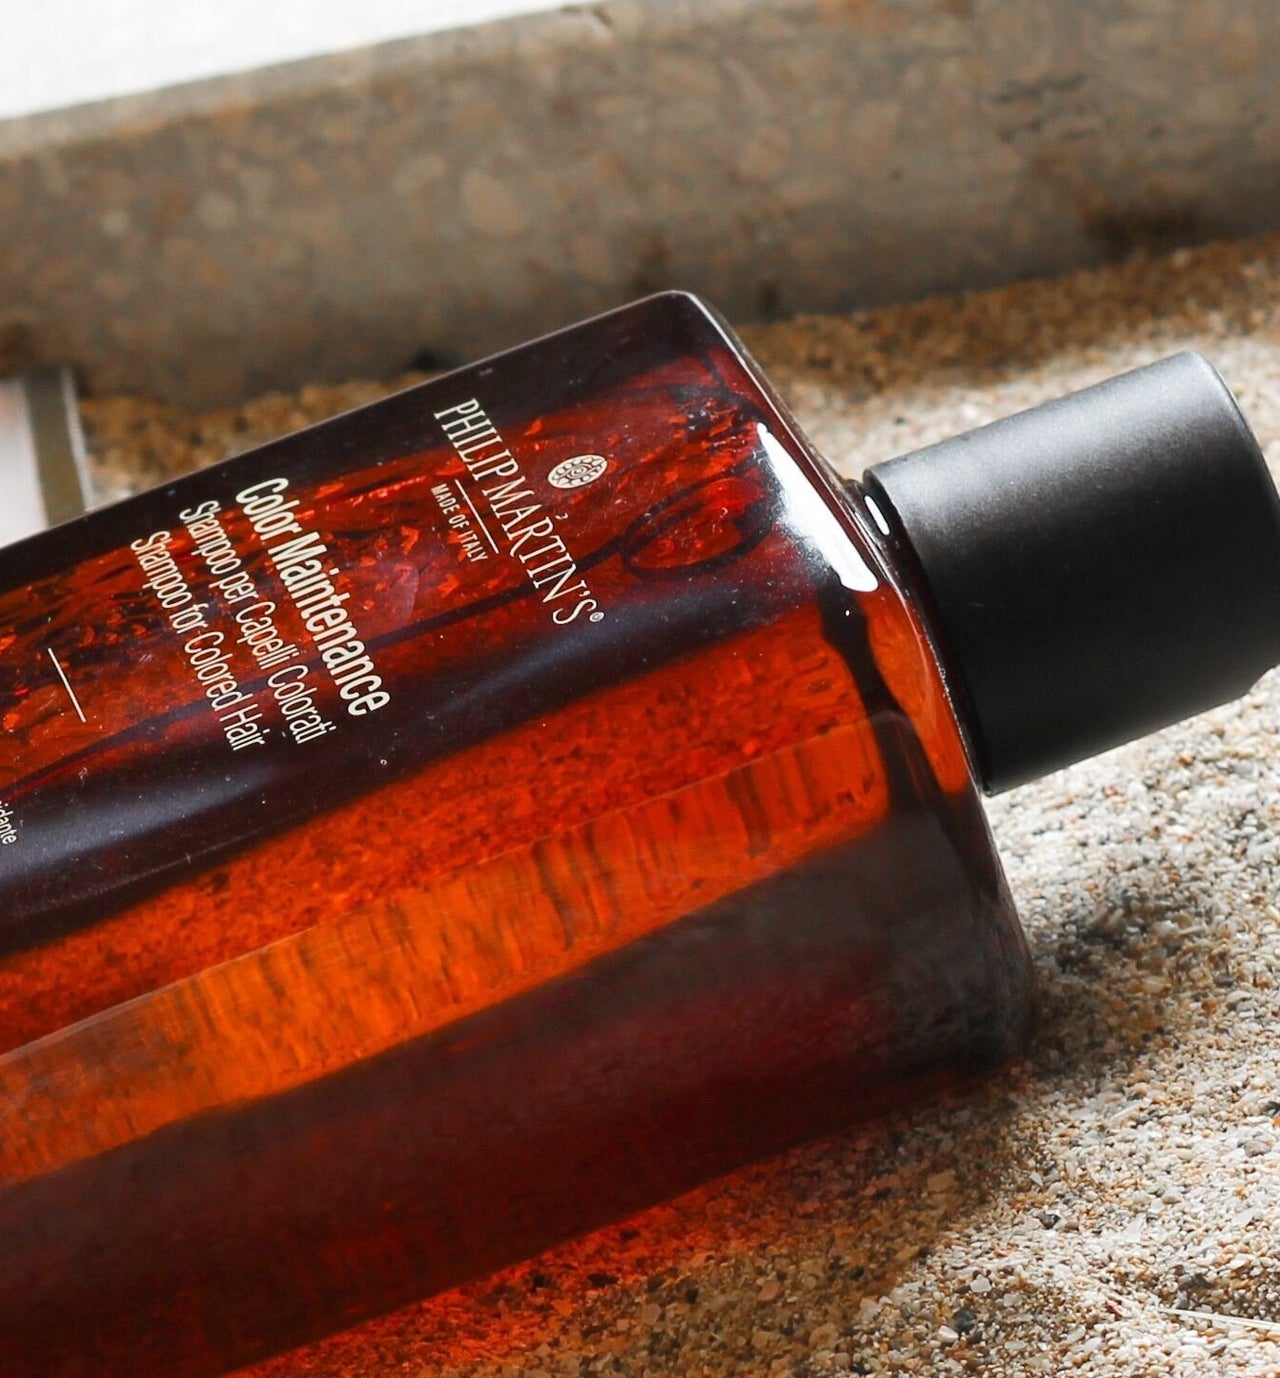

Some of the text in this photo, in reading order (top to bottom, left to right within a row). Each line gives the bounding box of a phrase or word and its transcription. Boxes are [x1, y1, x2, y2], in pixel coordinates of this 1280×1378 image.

[179, 500, 336, 743] Shampoo per Capelli Colorati
[235, 477, 389, 715] Color Maintenance
[430, 483, 488, 562] MADE OF ITALY
[130, 530, 270, 750] Shampoo for Colored Hair
